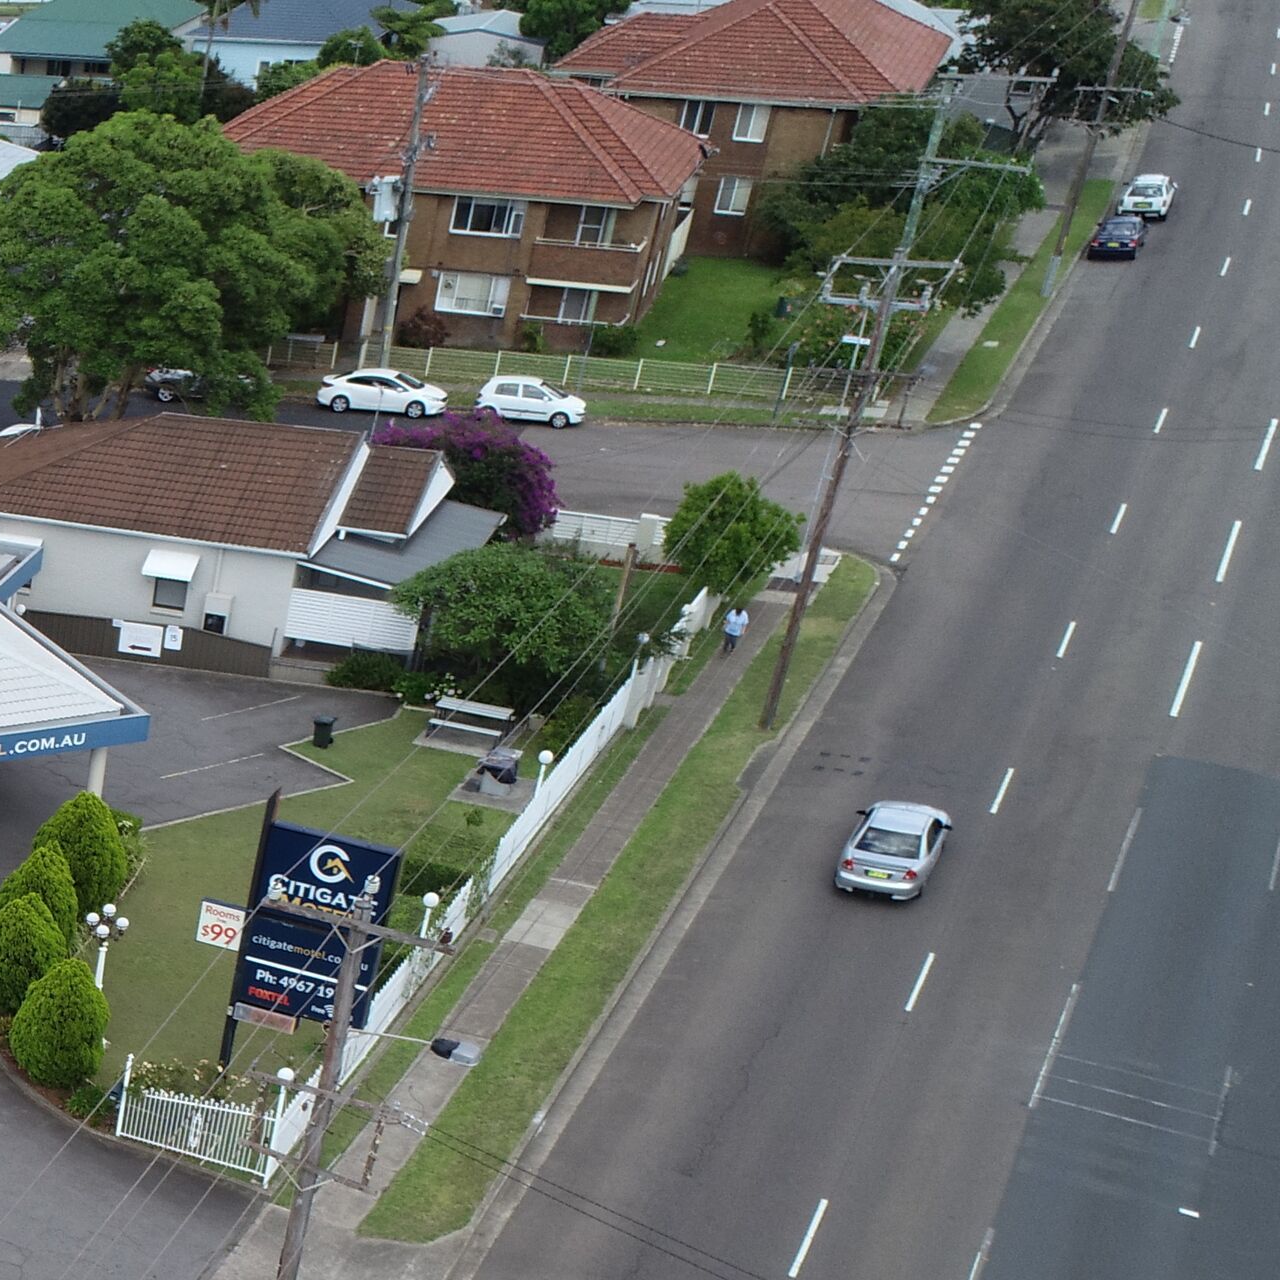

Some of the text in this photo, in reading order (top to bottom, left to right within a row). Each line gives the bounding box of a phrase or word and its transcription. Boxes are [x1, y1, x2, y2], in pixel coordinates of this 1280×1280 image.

[269, 873, 379, 916] CITIGAT
[205, 905, 241, 921] Rooms
[201, 923, 237, 944] $99
[255, 969, 277, 985] Ph:
[279, 976, 315, 994] 4967
